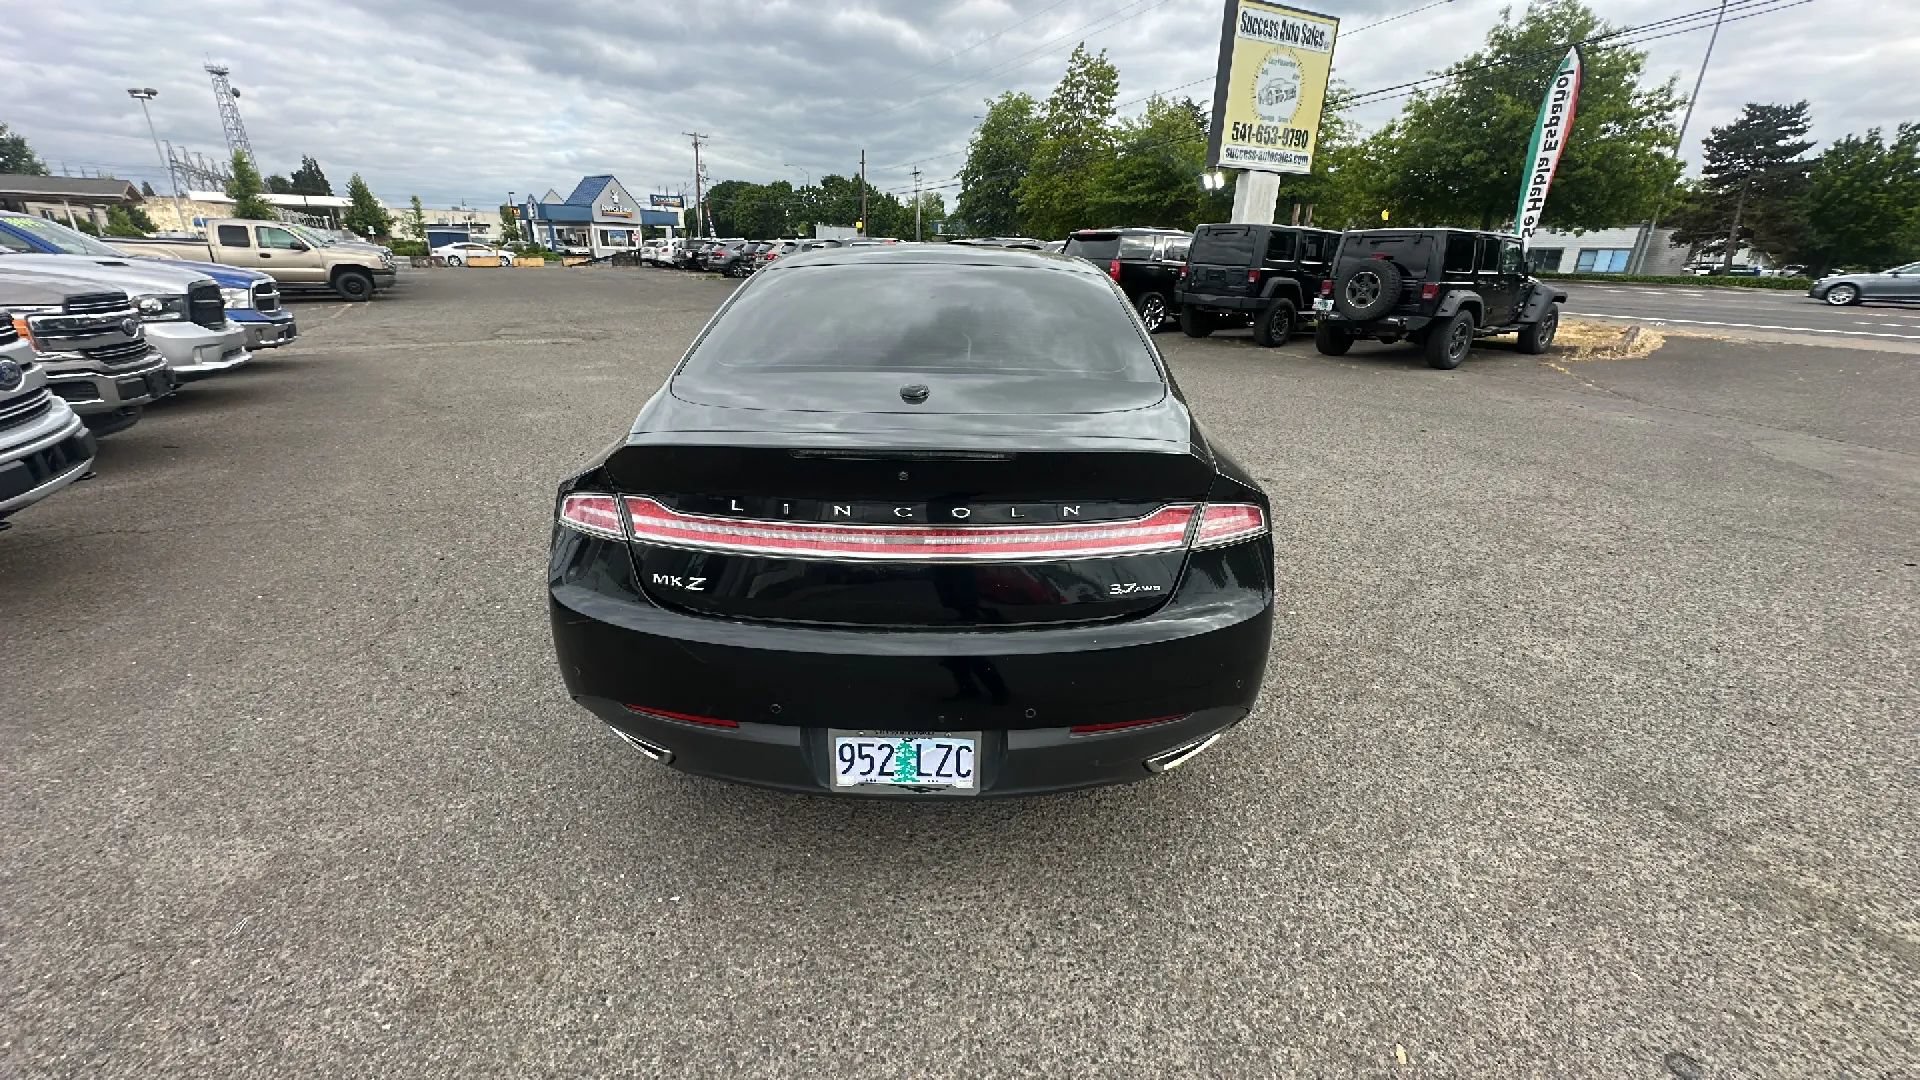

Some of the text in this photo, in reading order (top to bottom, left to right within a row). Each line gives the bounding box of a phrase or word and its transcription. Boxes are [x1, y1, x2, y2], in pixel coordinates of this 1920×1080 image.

[1240, 11, 1325, 48] Success Auto Sales
[1232, 121, 1309, 149] 541-653-9790
[1225, 147, 1309, 166] success-autosales.com
[731, 499, 1081, 518] LINCOLN
[838, 743, 973, 778] 952 LZC
